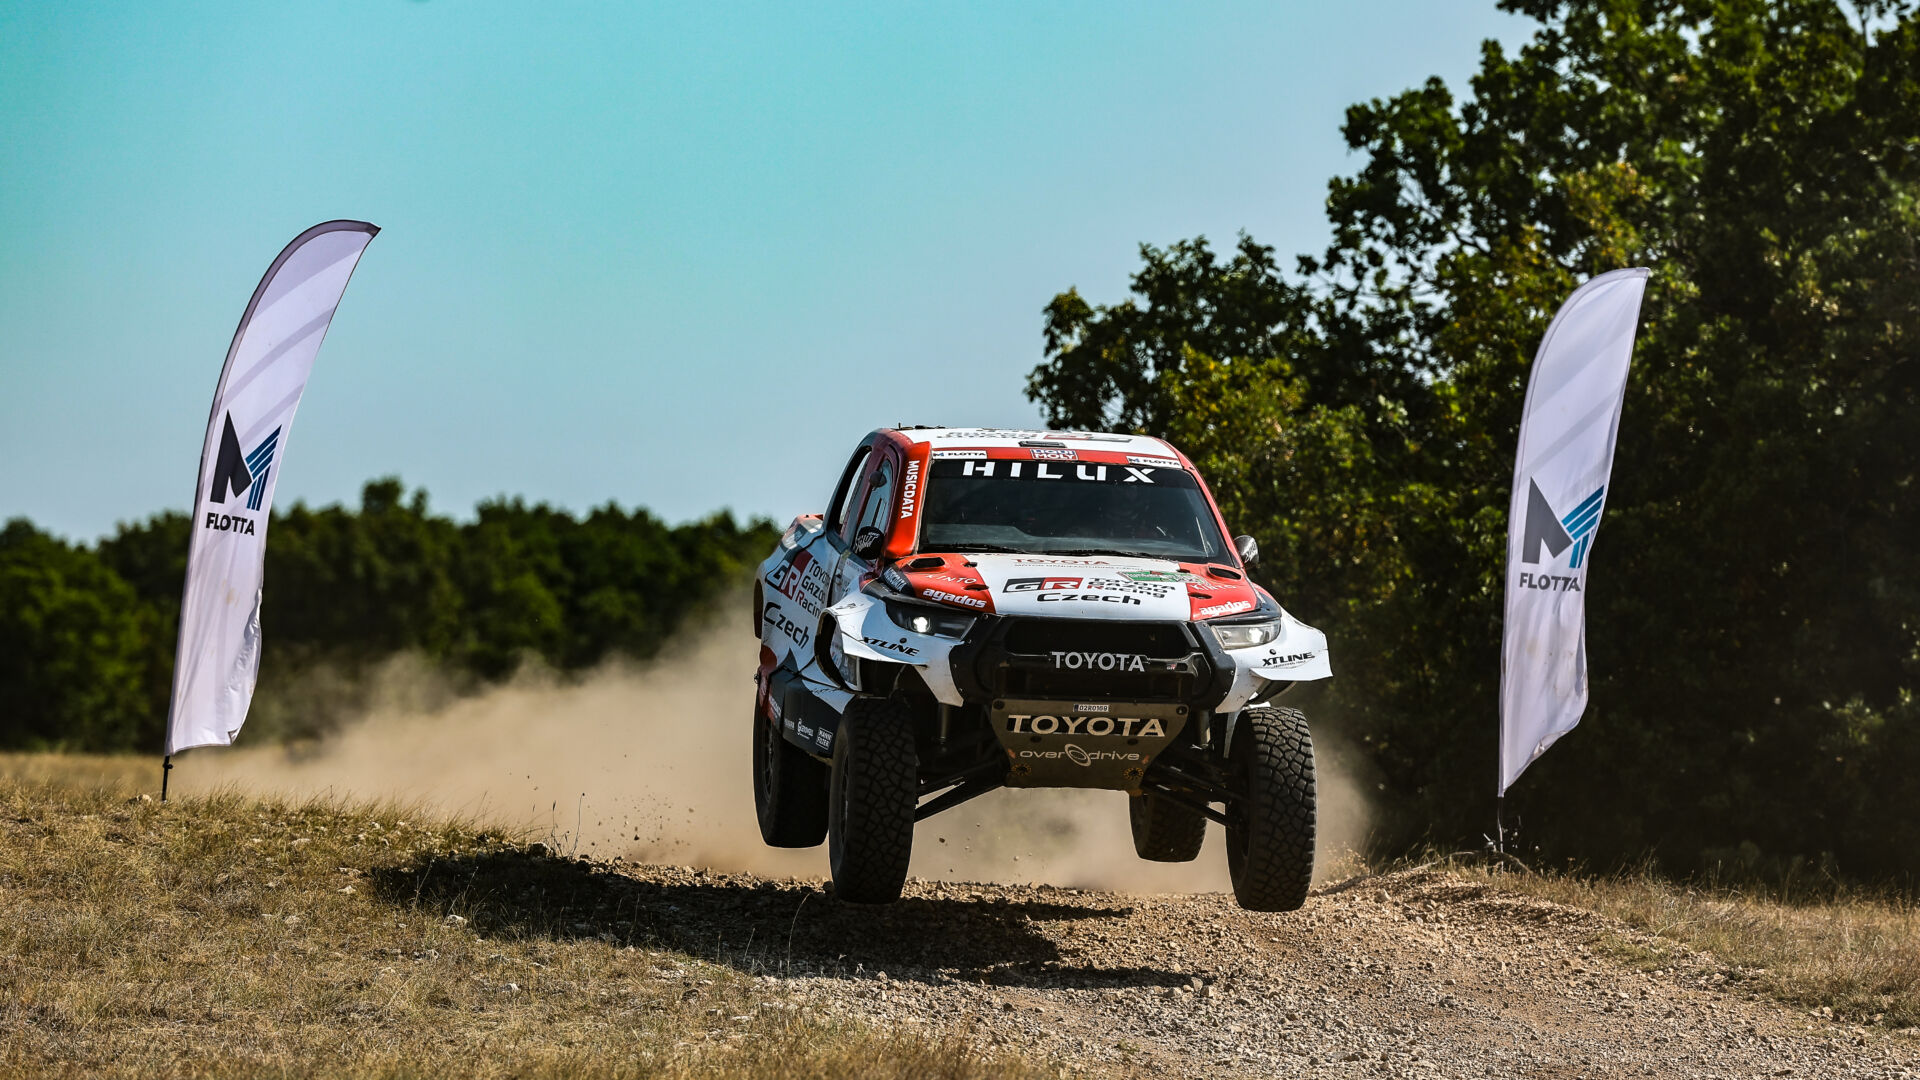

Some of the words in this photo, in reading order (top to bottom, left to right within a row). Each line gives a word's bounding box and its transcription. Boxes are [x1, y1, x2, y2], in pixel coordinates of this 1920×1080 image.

[962, 461, 1156, 483] HILUX
[901, 460, 920, 519] MUSICDATA
[206, 512, 255, 536] FLOTTA
[925, 569, 977, 584] KINTO
[1003, 578, 1083, 593] GR
[1088, 577, 1176, 591] TOYOTA
[1519, 572, 1582, 592] FLOTTA
[1087, 585, 1166, 599] Racing
[1088, 582, 1168, 594] GAZOO
[922, 588, 988, 608] agados
[1037, 593, 1141, 605] Czech
[1199, 600, 1251, 616] agados
[764, 602, 810, 649] Czech
[1051, 651, 1145, 672] TOYOTA
[1262, 652, 1316, 666] XTLINE
[1007, 714, 1166, 737] TOYOTA
